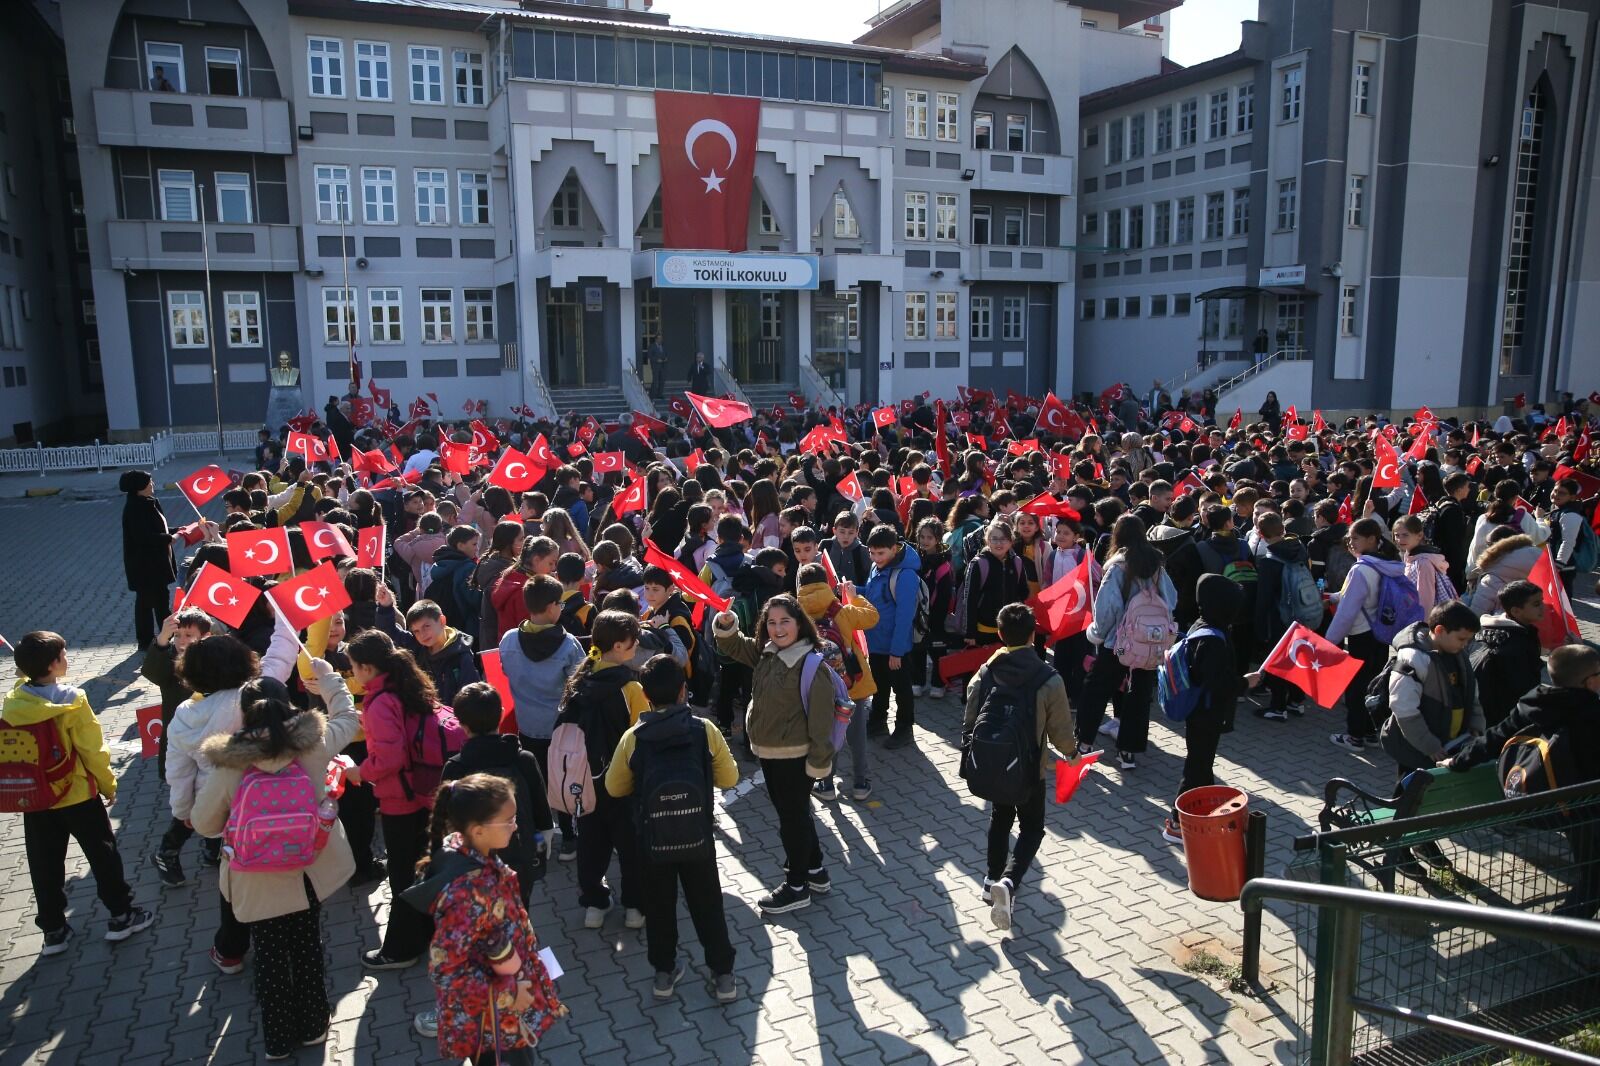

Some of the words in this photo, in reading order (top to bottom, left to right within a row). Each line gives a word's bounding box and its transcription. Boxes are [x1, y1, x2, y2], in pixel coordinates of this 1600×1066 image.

[694, 268, 723, 281] TOKİ
[726, 268, 787, 282] İLKOKULU
[660, 793, 688, 801] SPORT
